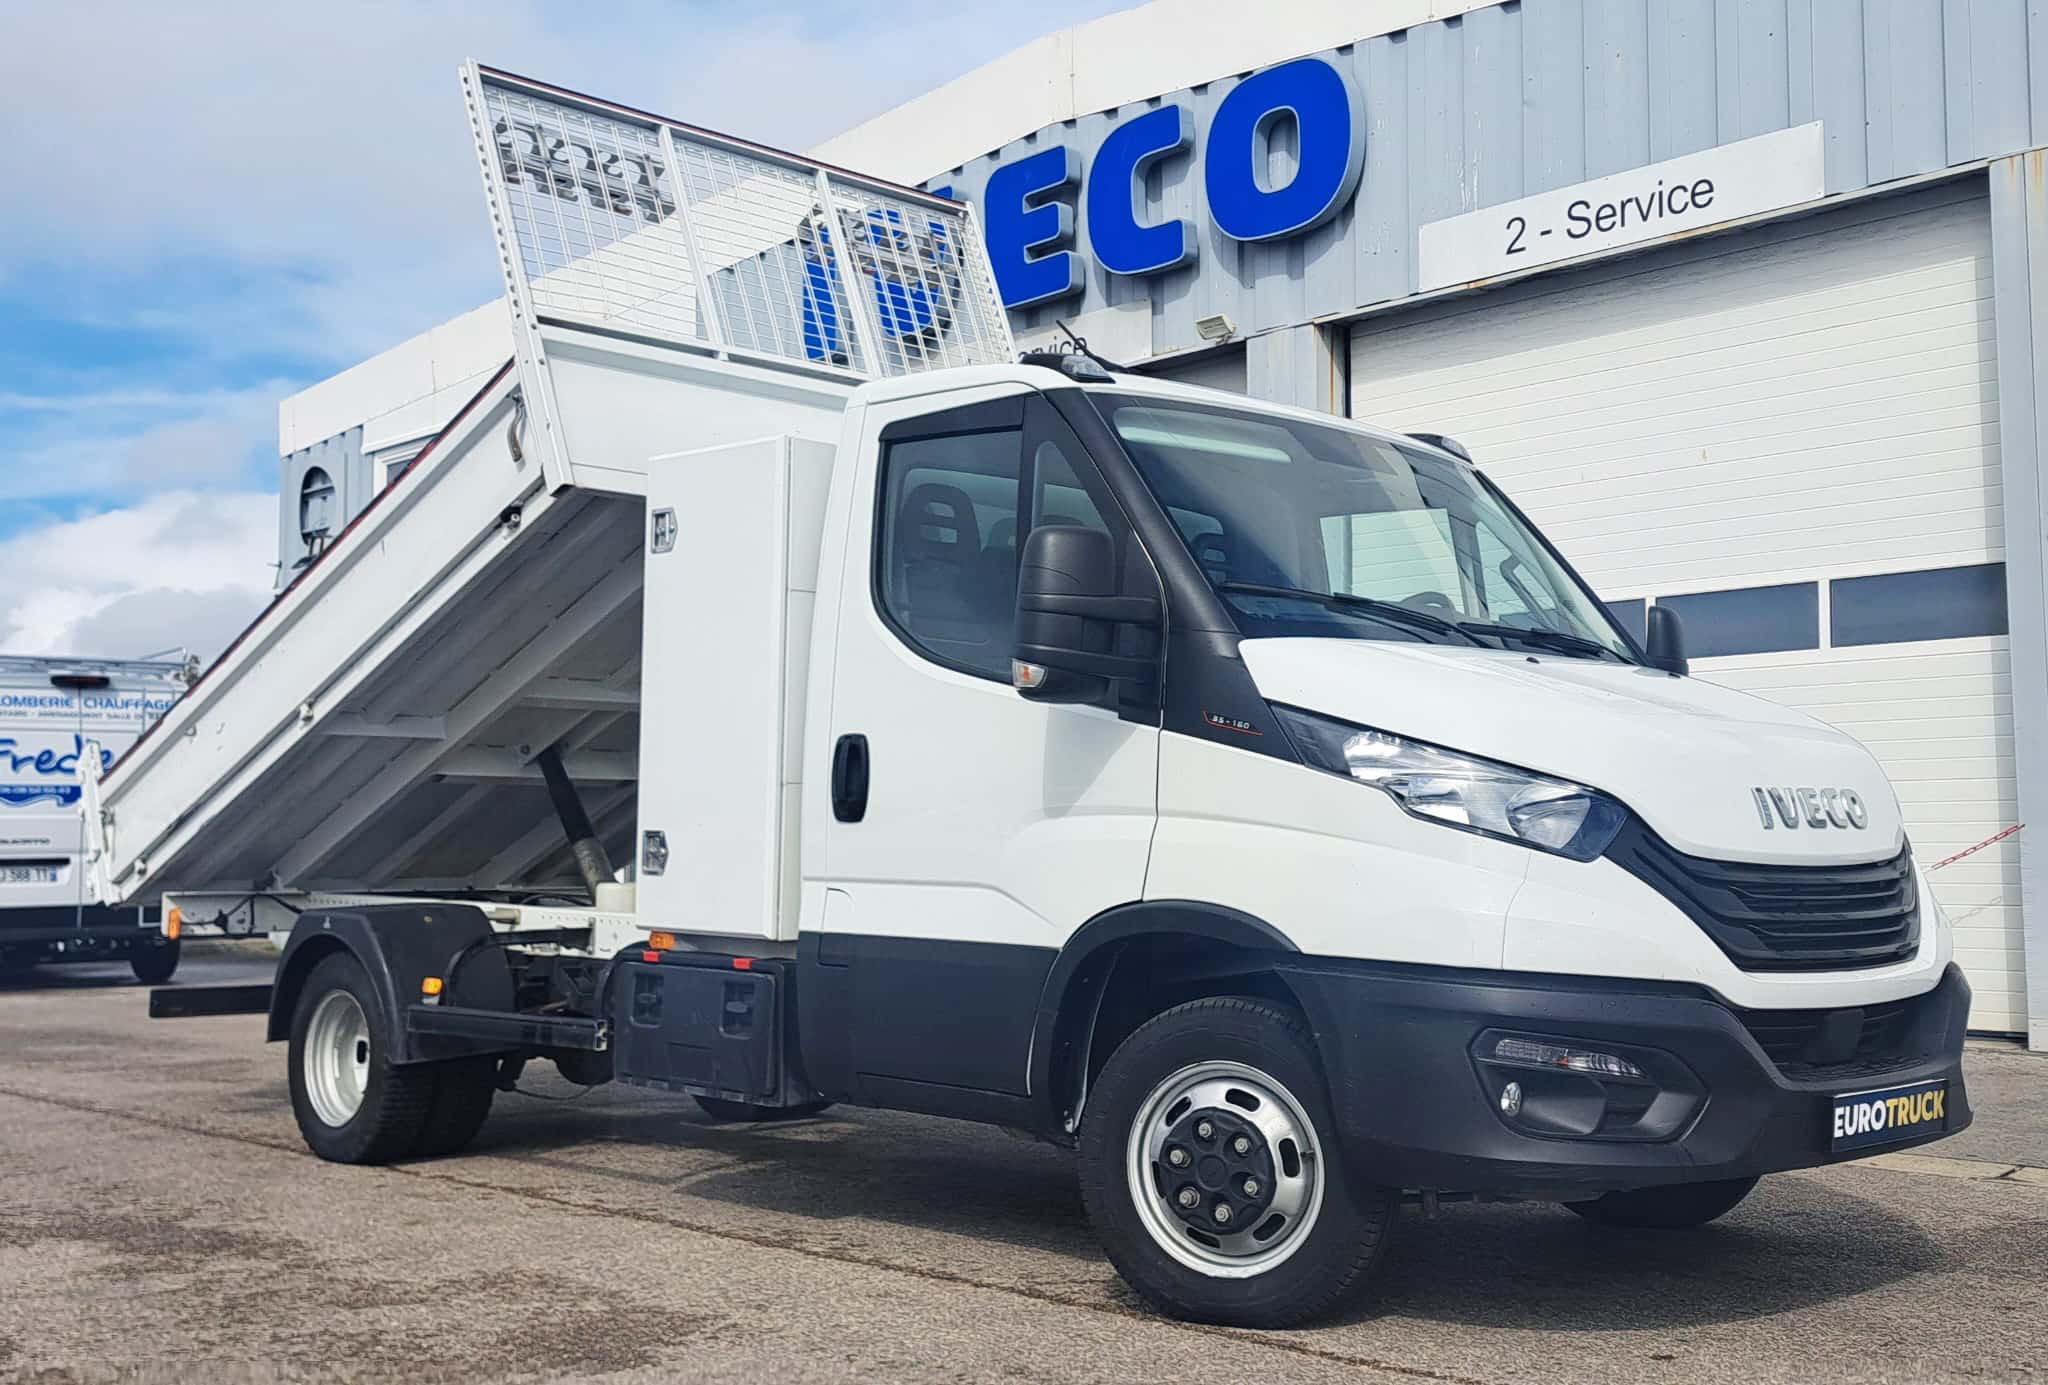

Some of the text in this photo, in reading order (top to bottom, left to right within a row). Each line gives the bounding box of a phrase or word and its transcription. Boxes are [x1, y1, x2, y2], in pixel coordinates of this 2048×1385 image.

[1505, 216, 1527, 256] 2
[1565, 178, 1715, 240] Service
[0, 694, 73, 709] OMBERIE
[1750, 785, 1869, 831] IVECO
[1832, 1089, 1945, 1139] EUROTRUCK
